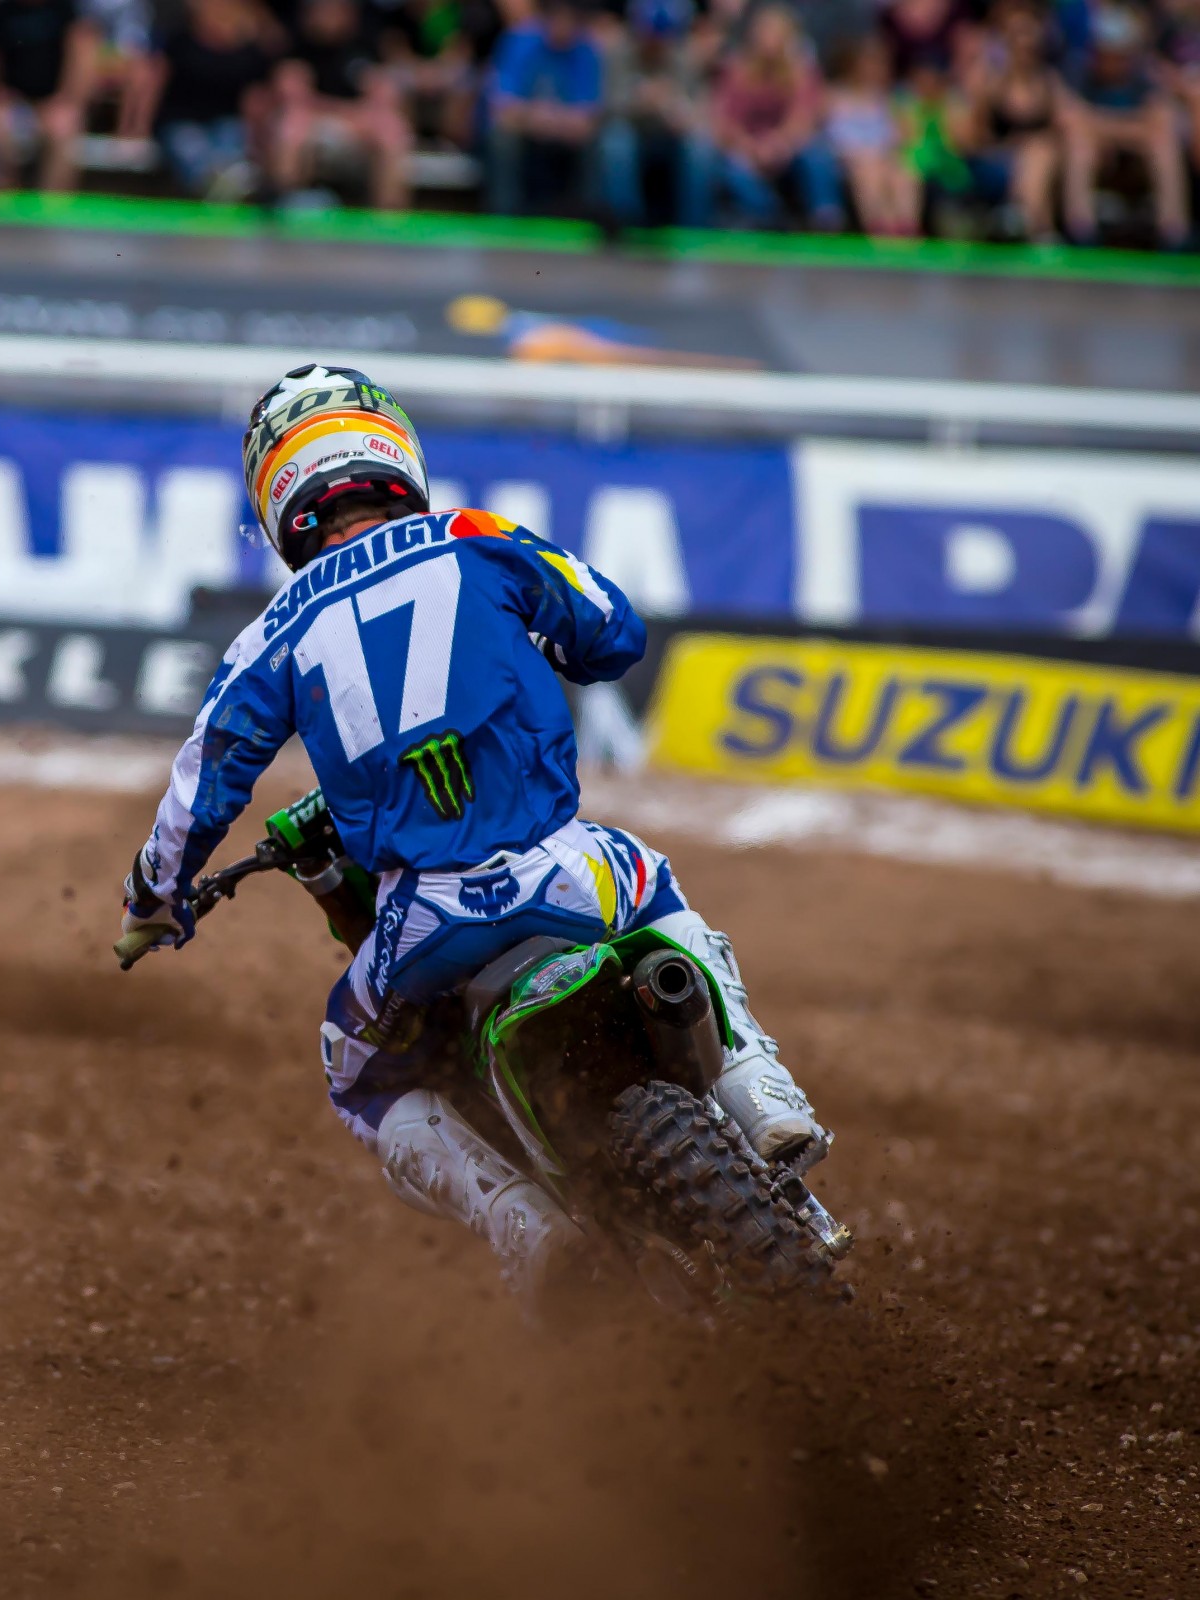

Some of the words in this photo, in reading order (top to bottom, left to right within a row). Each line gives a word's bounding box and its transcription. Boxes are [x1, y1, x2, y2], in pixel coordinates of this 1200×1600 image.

[272, 469, 296, 501] BELL
[369, 437, 400, 461] BELL
[293, 552, 462, 763] 17
[718, 666, 1200, 802] SUZUKI
